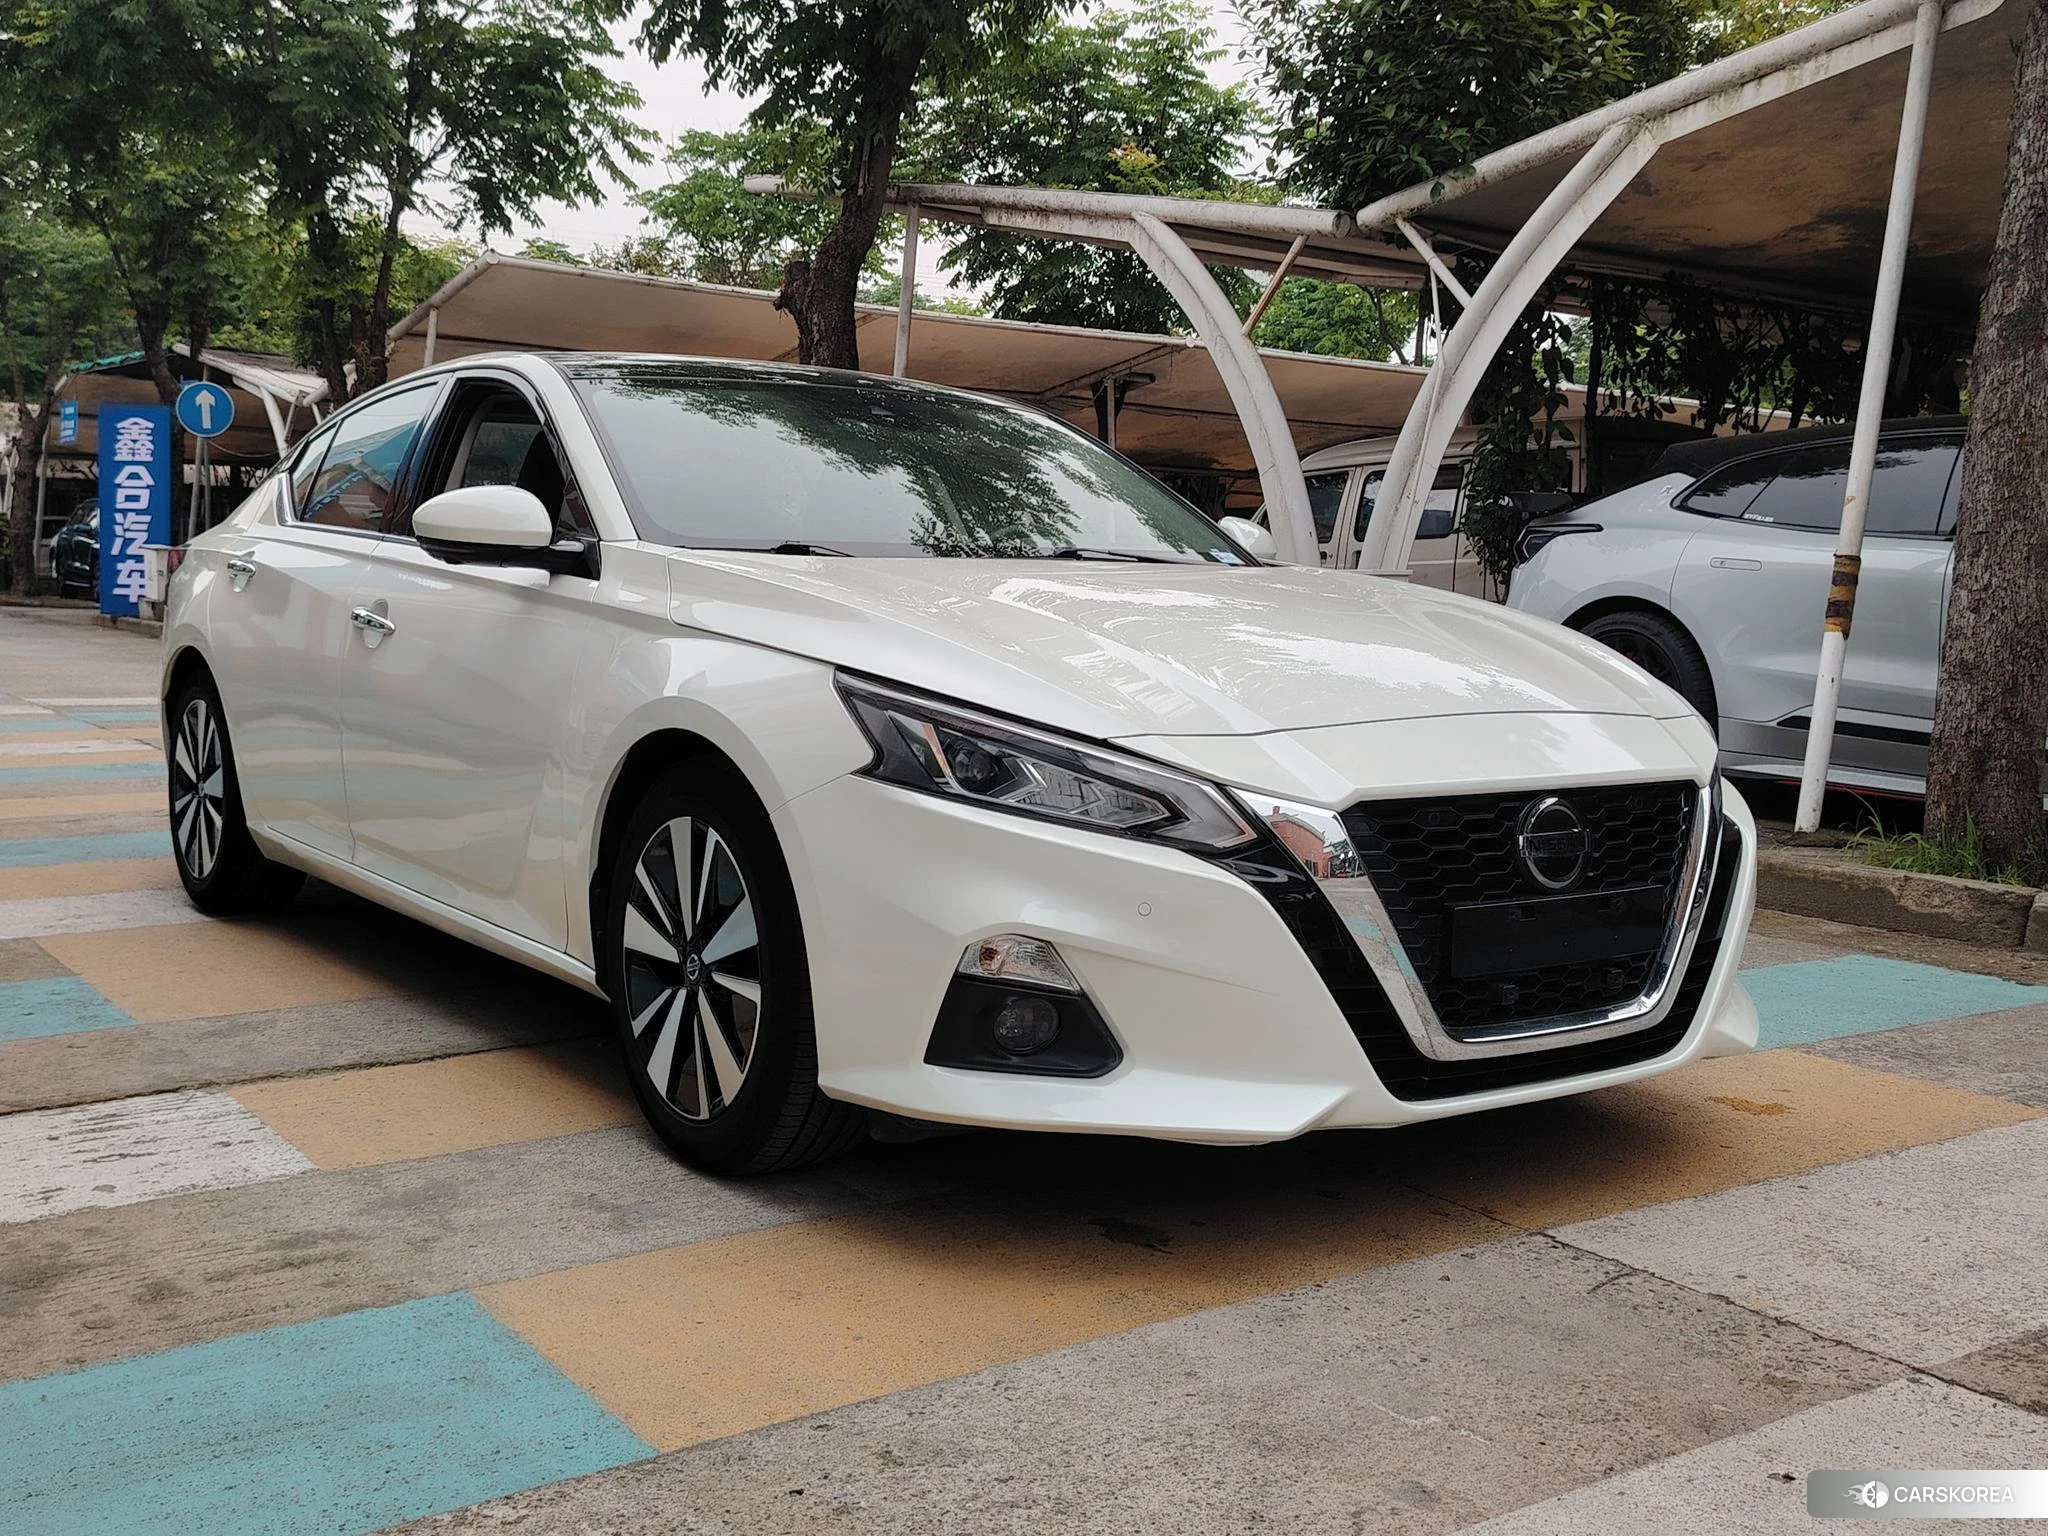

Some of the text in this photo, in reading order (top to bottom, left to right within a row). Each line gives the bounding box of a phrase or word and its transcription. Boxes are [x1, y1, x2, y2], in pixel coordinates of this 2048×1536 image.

[110, 416, 155, 604] 鑫合汽车
[1529, 835, 1583, 852] NISS
